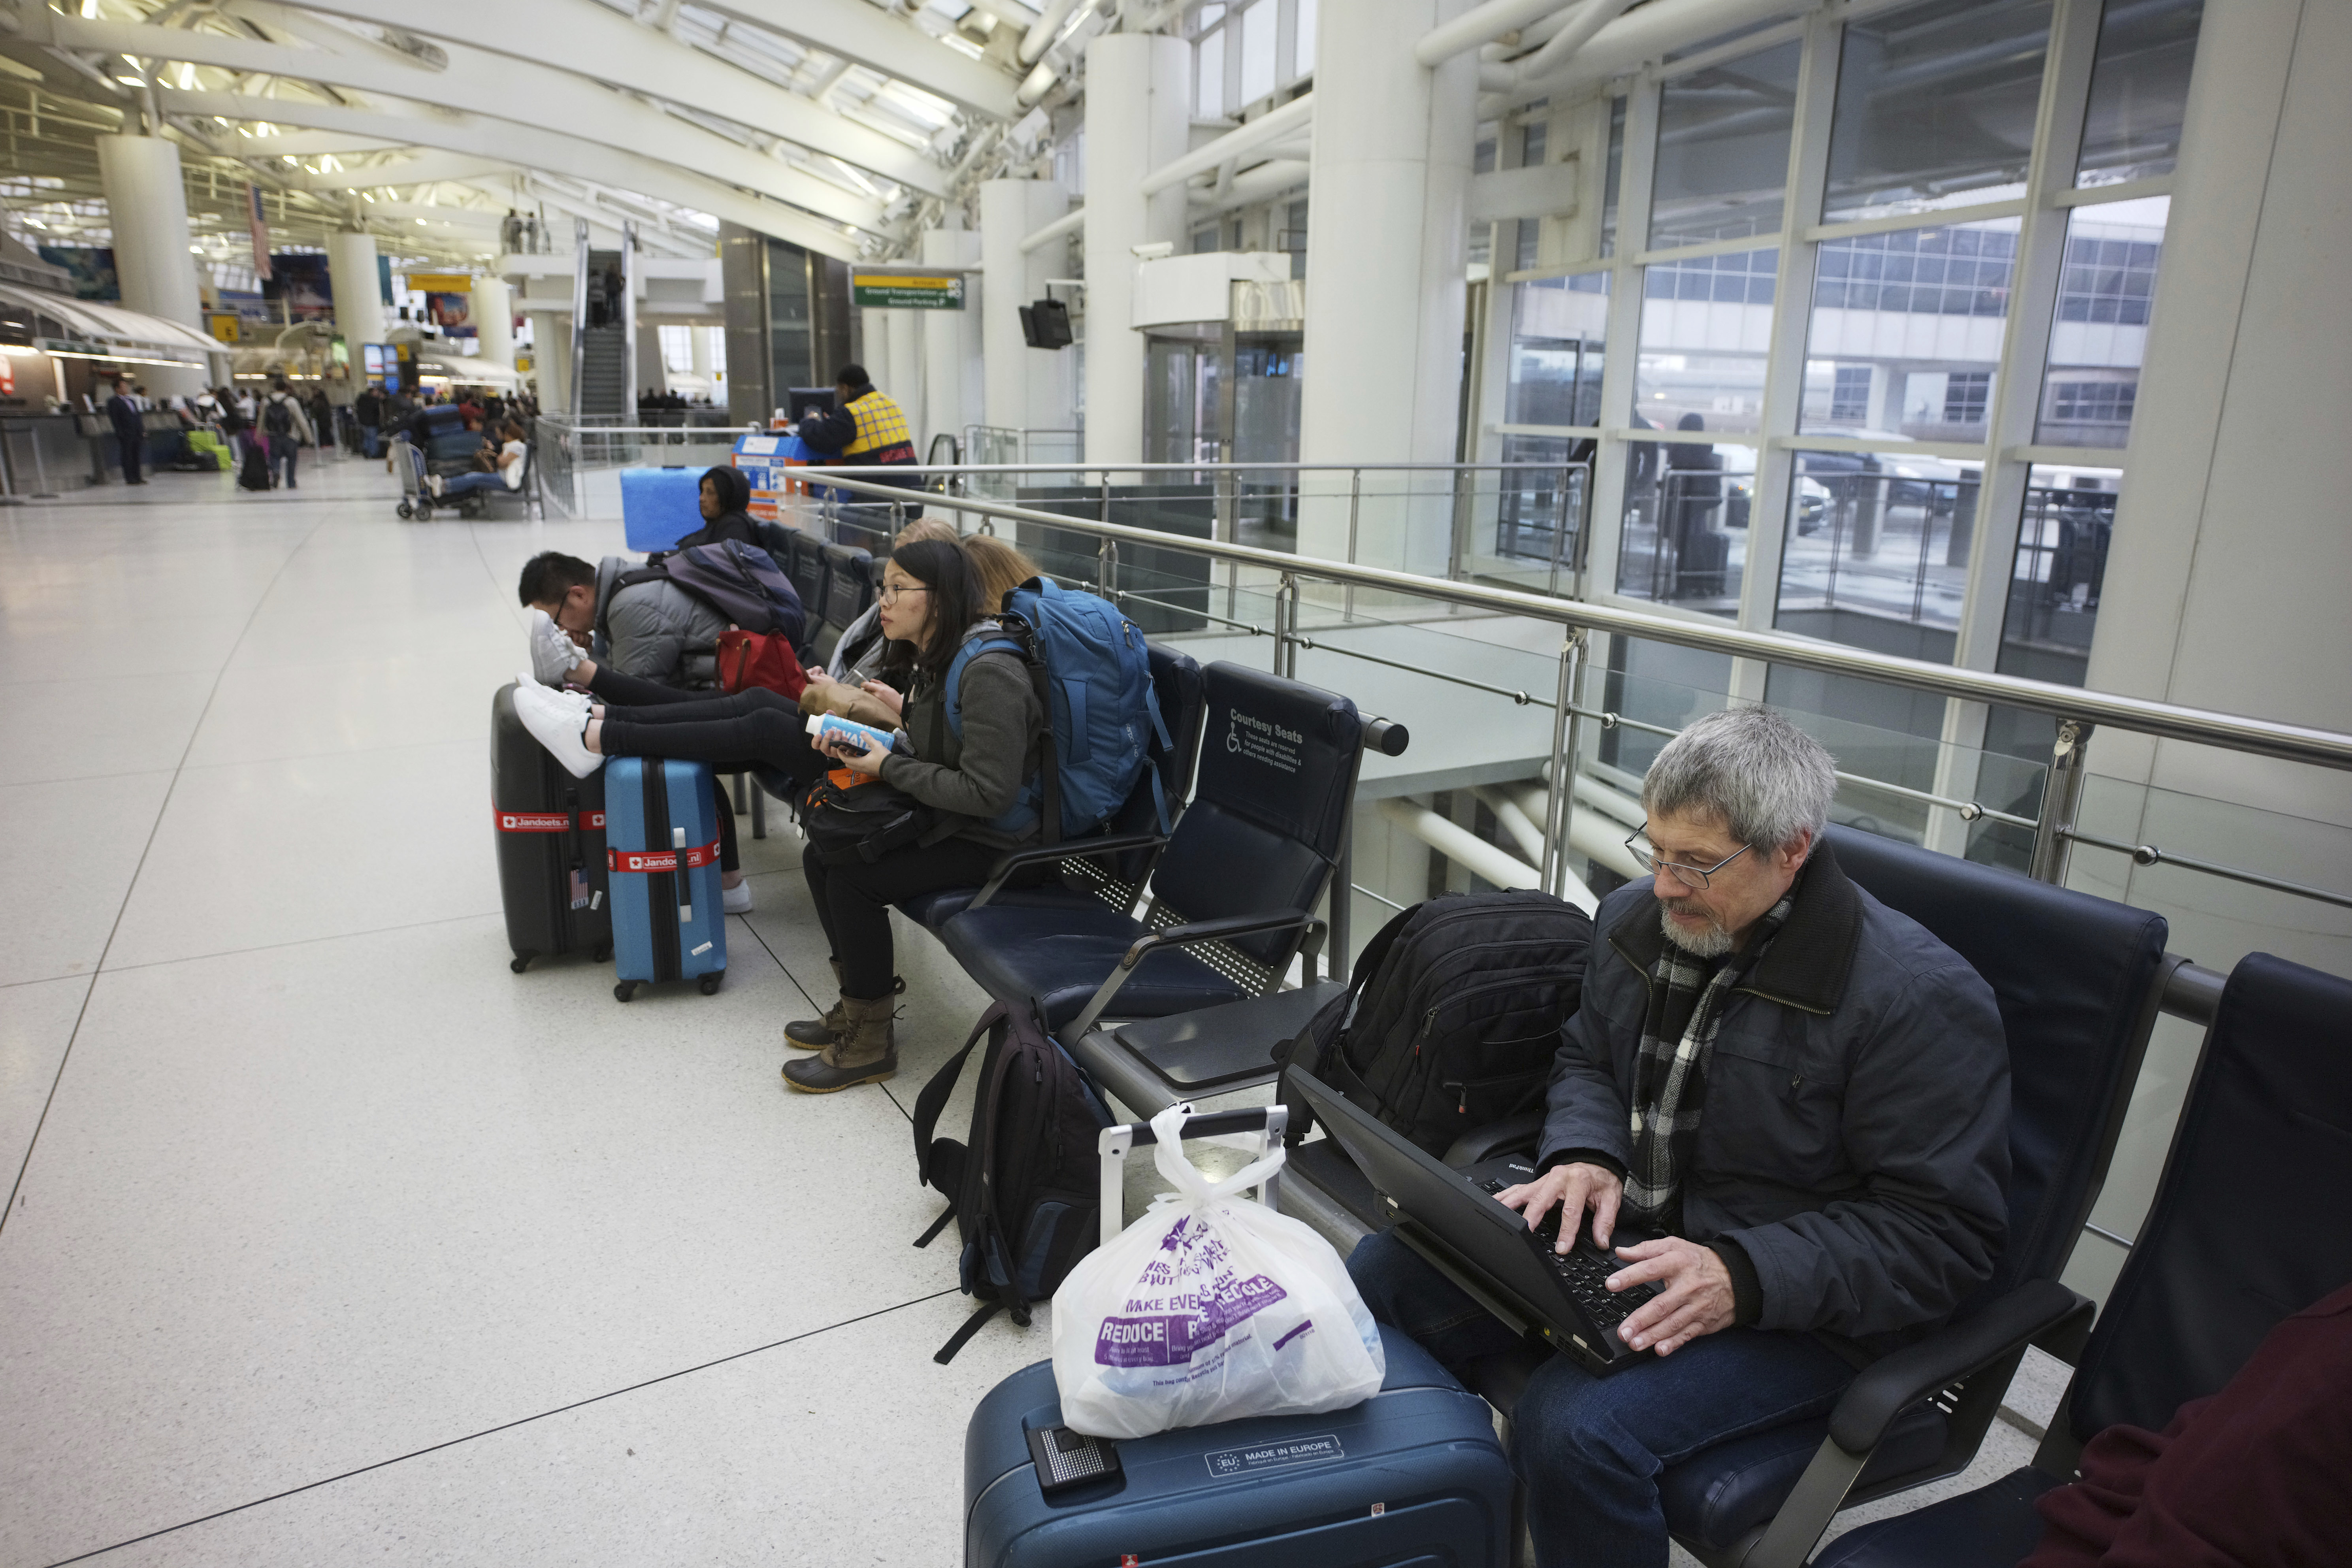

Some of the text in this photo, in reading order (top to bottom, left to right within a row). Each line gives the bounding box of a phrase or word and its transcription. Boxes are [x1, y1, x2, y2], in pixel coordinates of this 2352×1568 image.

[1231, 708, 1302, 744] Courtesy Seats
[1246, 731, 1258, 741] These
[1259, 737, 1270, 745] seats
[1278, 744, 1295, 754] reserved
[1251, 743, 1265, 752] people
[1275, 751, 1297, 764] disabilities
[1243, 749, 1295, 773] others needing assistance
[517, 818, 569, 826] Jandoets.n
[645, 854, 699, 867] Jandoe.nl
[1509, 1163, 1534, 1173] ThinkPad
[1126, 1298, 1163, 1312] MAKE
[1101, 1322, 1164, 1344] REDUCE
[1231, 1334, 1253, 1348] material.
[1191, 1368, 1210, 1380] Recycle
[1245, 1442, 1332, 1461] MADE IN EUROPE
[1221, 1458, 1236, 1467] EU
